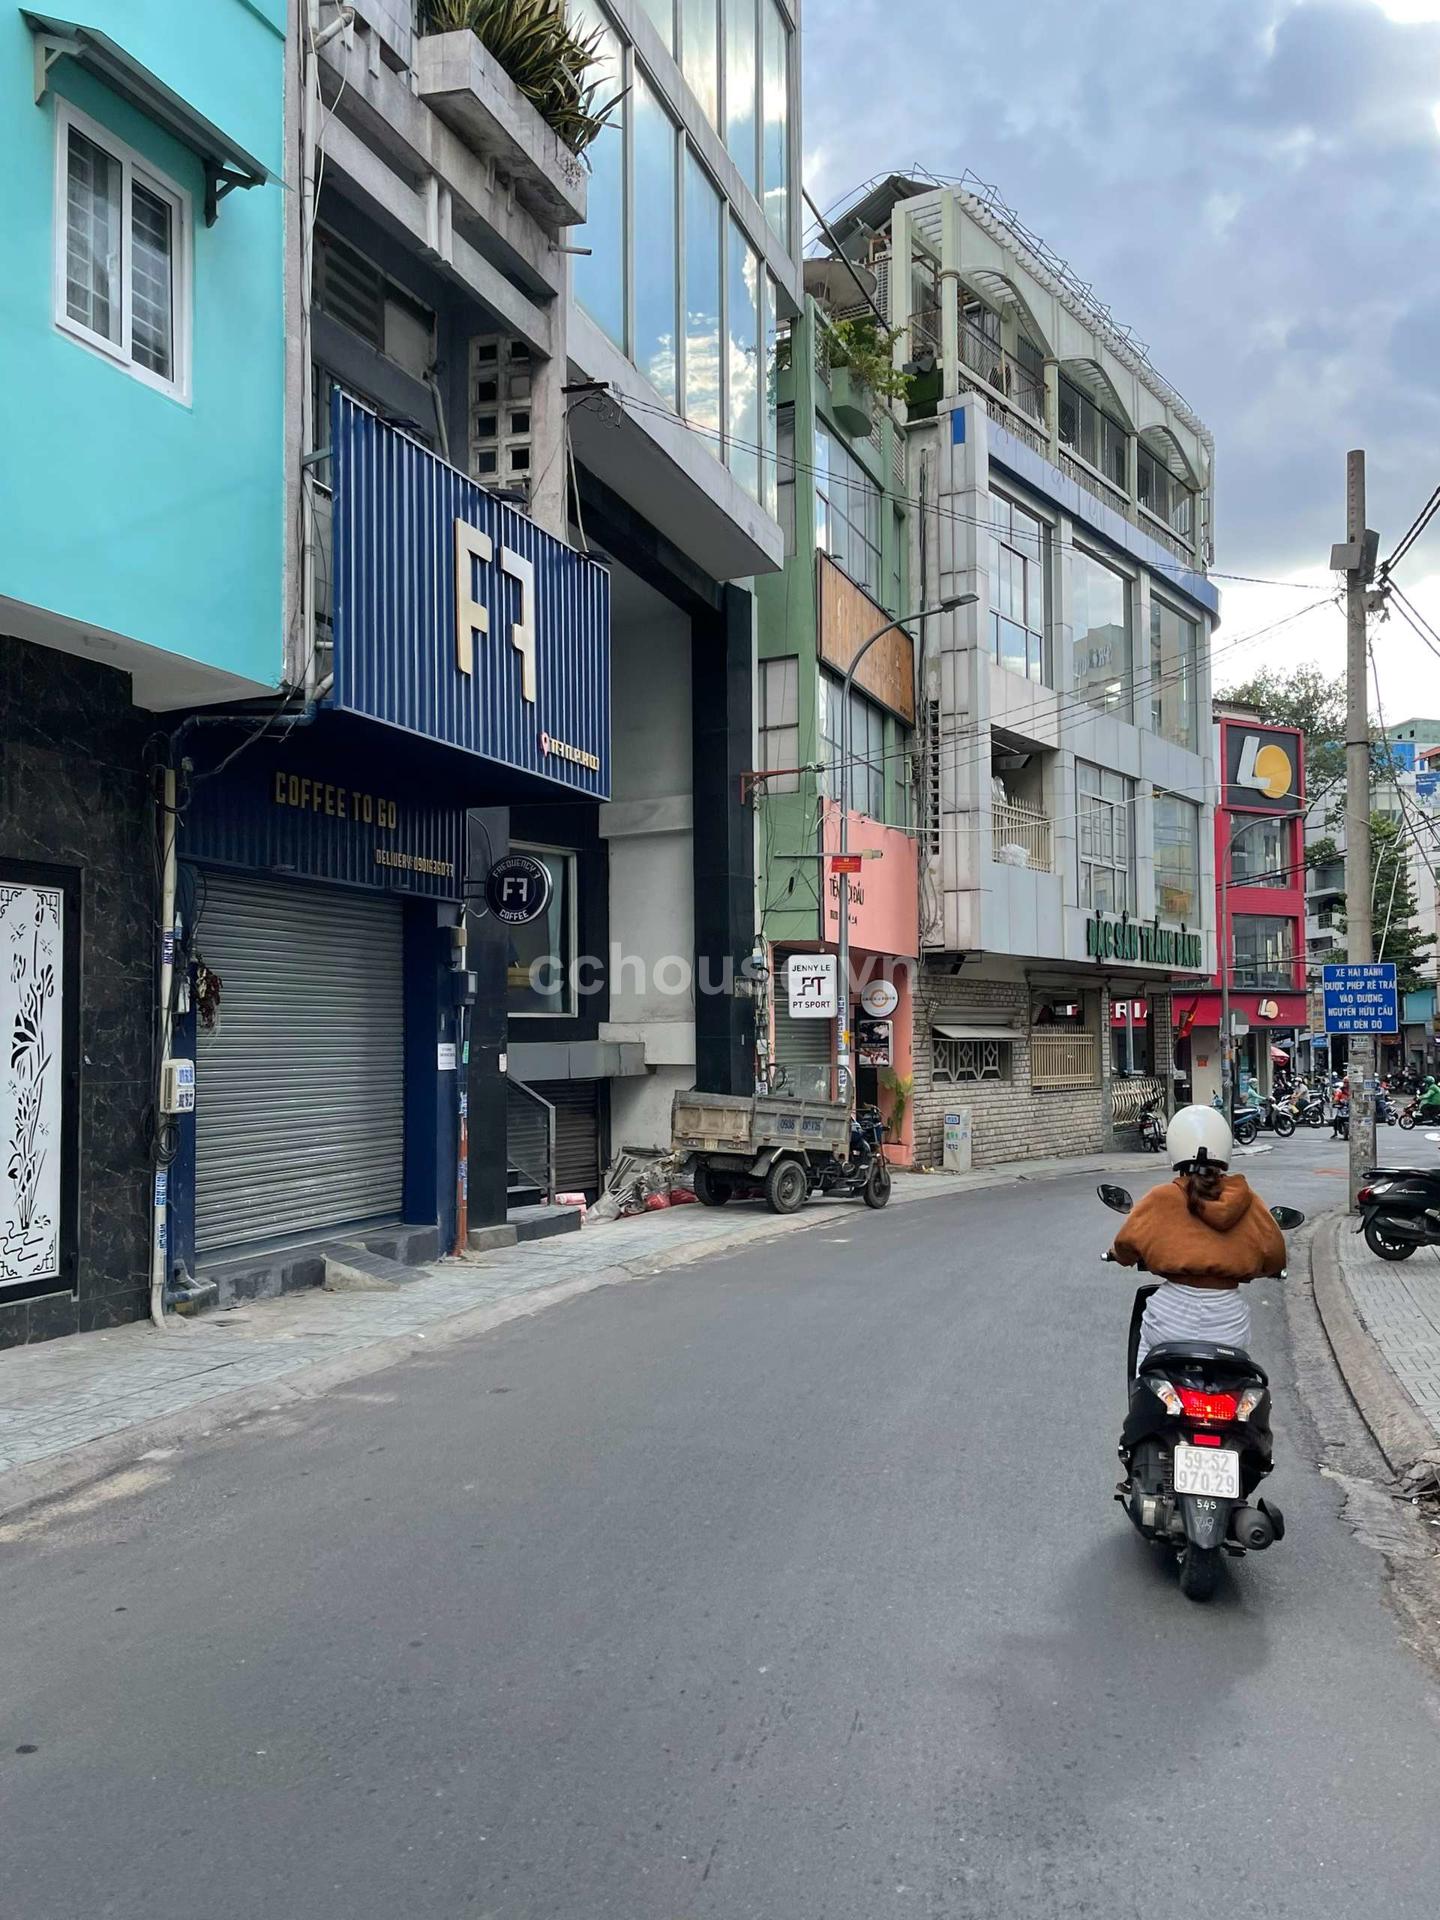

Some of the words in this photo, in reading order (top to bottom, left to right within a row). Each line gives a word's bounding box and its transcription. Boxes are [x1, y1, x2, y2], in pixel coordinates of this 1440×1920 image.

[275, 771, 346, 818] COFFEE
[353, 791, 373, 824] TO
[377, 798, 397, 830] GO
[492, 858, 537, 878] FREQUENCY
[499, 908, 529, 921] COFFEE
[1086, 909, 1113, 964] ĐẶC
[1113, 910, 1139, 960] SẢN
[1174, 922, 1202, 968] BÀNG
[792, 964, 818, 972] JENNY
[820, 964, 831, 972] LE
[1336, 968, 1345, 977] XE
[1348, 968, 1360, 977] HAI
[1363, 965, 1383, 977] BÁNH
[1325, 980, 1345, 991] ĐƯỢC
[1347, 979, 1365, 991] PHÉP
[1339, 993, 1354, 1004] VÀO
[1357, 993, 1383, 1003] ĐƯỜNG
[792, 1001, 803, 1009] PT
[805, 1001, 831, 1009] SPORT
[1328, 1004, 1357, 1016] NGUYỄN
[1338, 1021, 1351, 1030] KHI
[1184, 1451, 1229, 1474] 59-S2
[1179, 1471, 1235, 1494] 970.29
